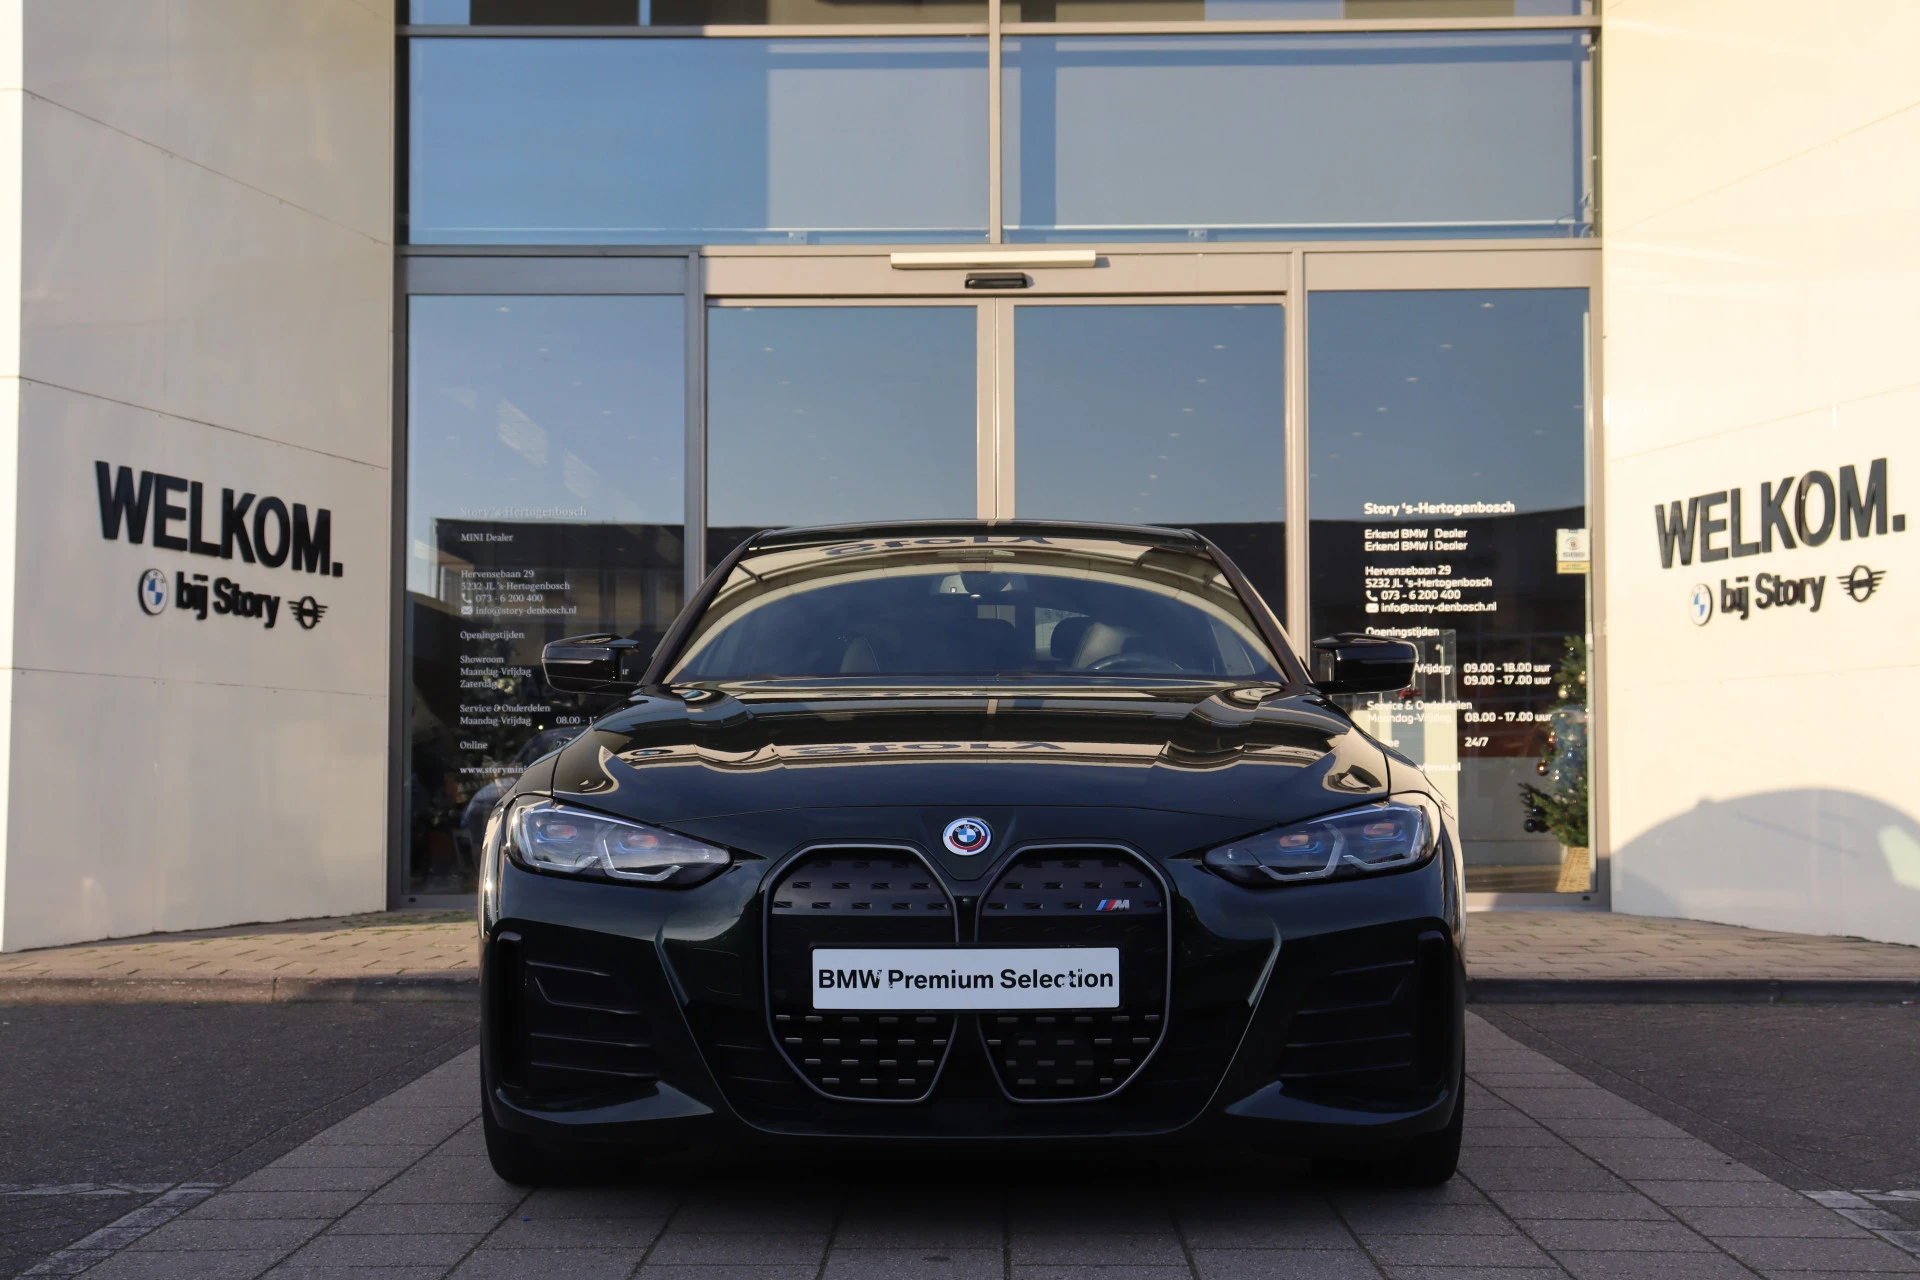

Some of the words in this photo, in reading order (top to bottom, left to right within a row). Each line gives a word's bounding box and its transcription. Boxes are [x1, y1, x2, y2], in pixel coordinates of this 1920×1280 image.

[1363, 502, 1400, 516] Story
[1401, 501, 1515, 516] 's-Hertogenbosch
[1654, 457, 1906, 569] WELKOM.
[95, 460, 343, 577] WELKOM.
[460, 533, 483, 542] MINI
[486, 533, 514, 542] Dealer
[1364, 528, 1400, 539] Erkend
[1401, 528, 1428, 539] BMW
[1434, 528, 1468, 539] Dealer
[1364, 541, 1400, 551] Erkend
[1401, 541, 1429, 551] BMW
[1429, 541, 1434, 550] i
[1434, 540, 1468, 550] Dealer
[461, 569, 521, 578] Hervensebaan
[523, 569, 535, 578] 29
[1365, 565, 1436, 576] Hervensebaan
[1437, 565, 1452, 575] 29
[461, 582, 482, 591] 5232
[485, 582, 495, 591] JL
[1365, 577, 1391, 588] 5232
[1391, 578, 1404, 588] JL
[1404, 577, 1493, 589] 's-Hertogenbosch
[175, 571, 208, 620] bij
[212, 577, 280, 629] Story
[475, 594, 492, 602] 073
[500, 594, 506, 602] 6
[508, 594, 524, 602] 200
[526, 593, 543, 602] 400
[1380, 590, 1400, 600] 073
[1408, 590, 1417, 600] 6
[1417, 589, 1439, 600] 200
[1439, 589, 1461, 600] 400
[1720, 576, 1749, 621] bij
[1755, 572, 1826, 613] Story
[475, 605, 577, 616] info@story-denbosch.nl
[1381, 601, 1497, 614] info@story-denbosch.nl
[460, 631, 525, 641] Openingstijden
[1365, 627, 1440, 638] Openingstijden
[460, 655, 504, 664] Showroom
[460, 667, 532, 678] Maandag-Vrijdag
[1415, 663, 1451, 675] Vrijdag
[1463, 662, 1495, 673] 09.00
[1502, 662, 1532, 673] 18.00
[1533, 664, 1551, 672] uur
[460, 680, 497, 690] Zaterdag
[1463, 675, 1495, 685] 09.00
[1533, 677, 1552, 685] uur
[460, 704, 492, 713] Service
[493, 704, 501, 713] &
[502, 704, 551, 713] Onderdelen
[1367, 700, 1403, 711] Service
[1404, 700, 1414, 710] &
[460, 716, 531, 727] Maandag-Vrijdag
[556, 716, 580, 725] 08.00
[1464, 712, 1496, 722] 08.00
[1534, 713, 1552, 722] uur
[460, 741, 488, 750] Online
[1464, 737, 1489, 747] 24/7
[818, 969, 882, 988] BMW
[888, 969, 993, 988] Premium
[1000, 968, 1113, 988] Selection
